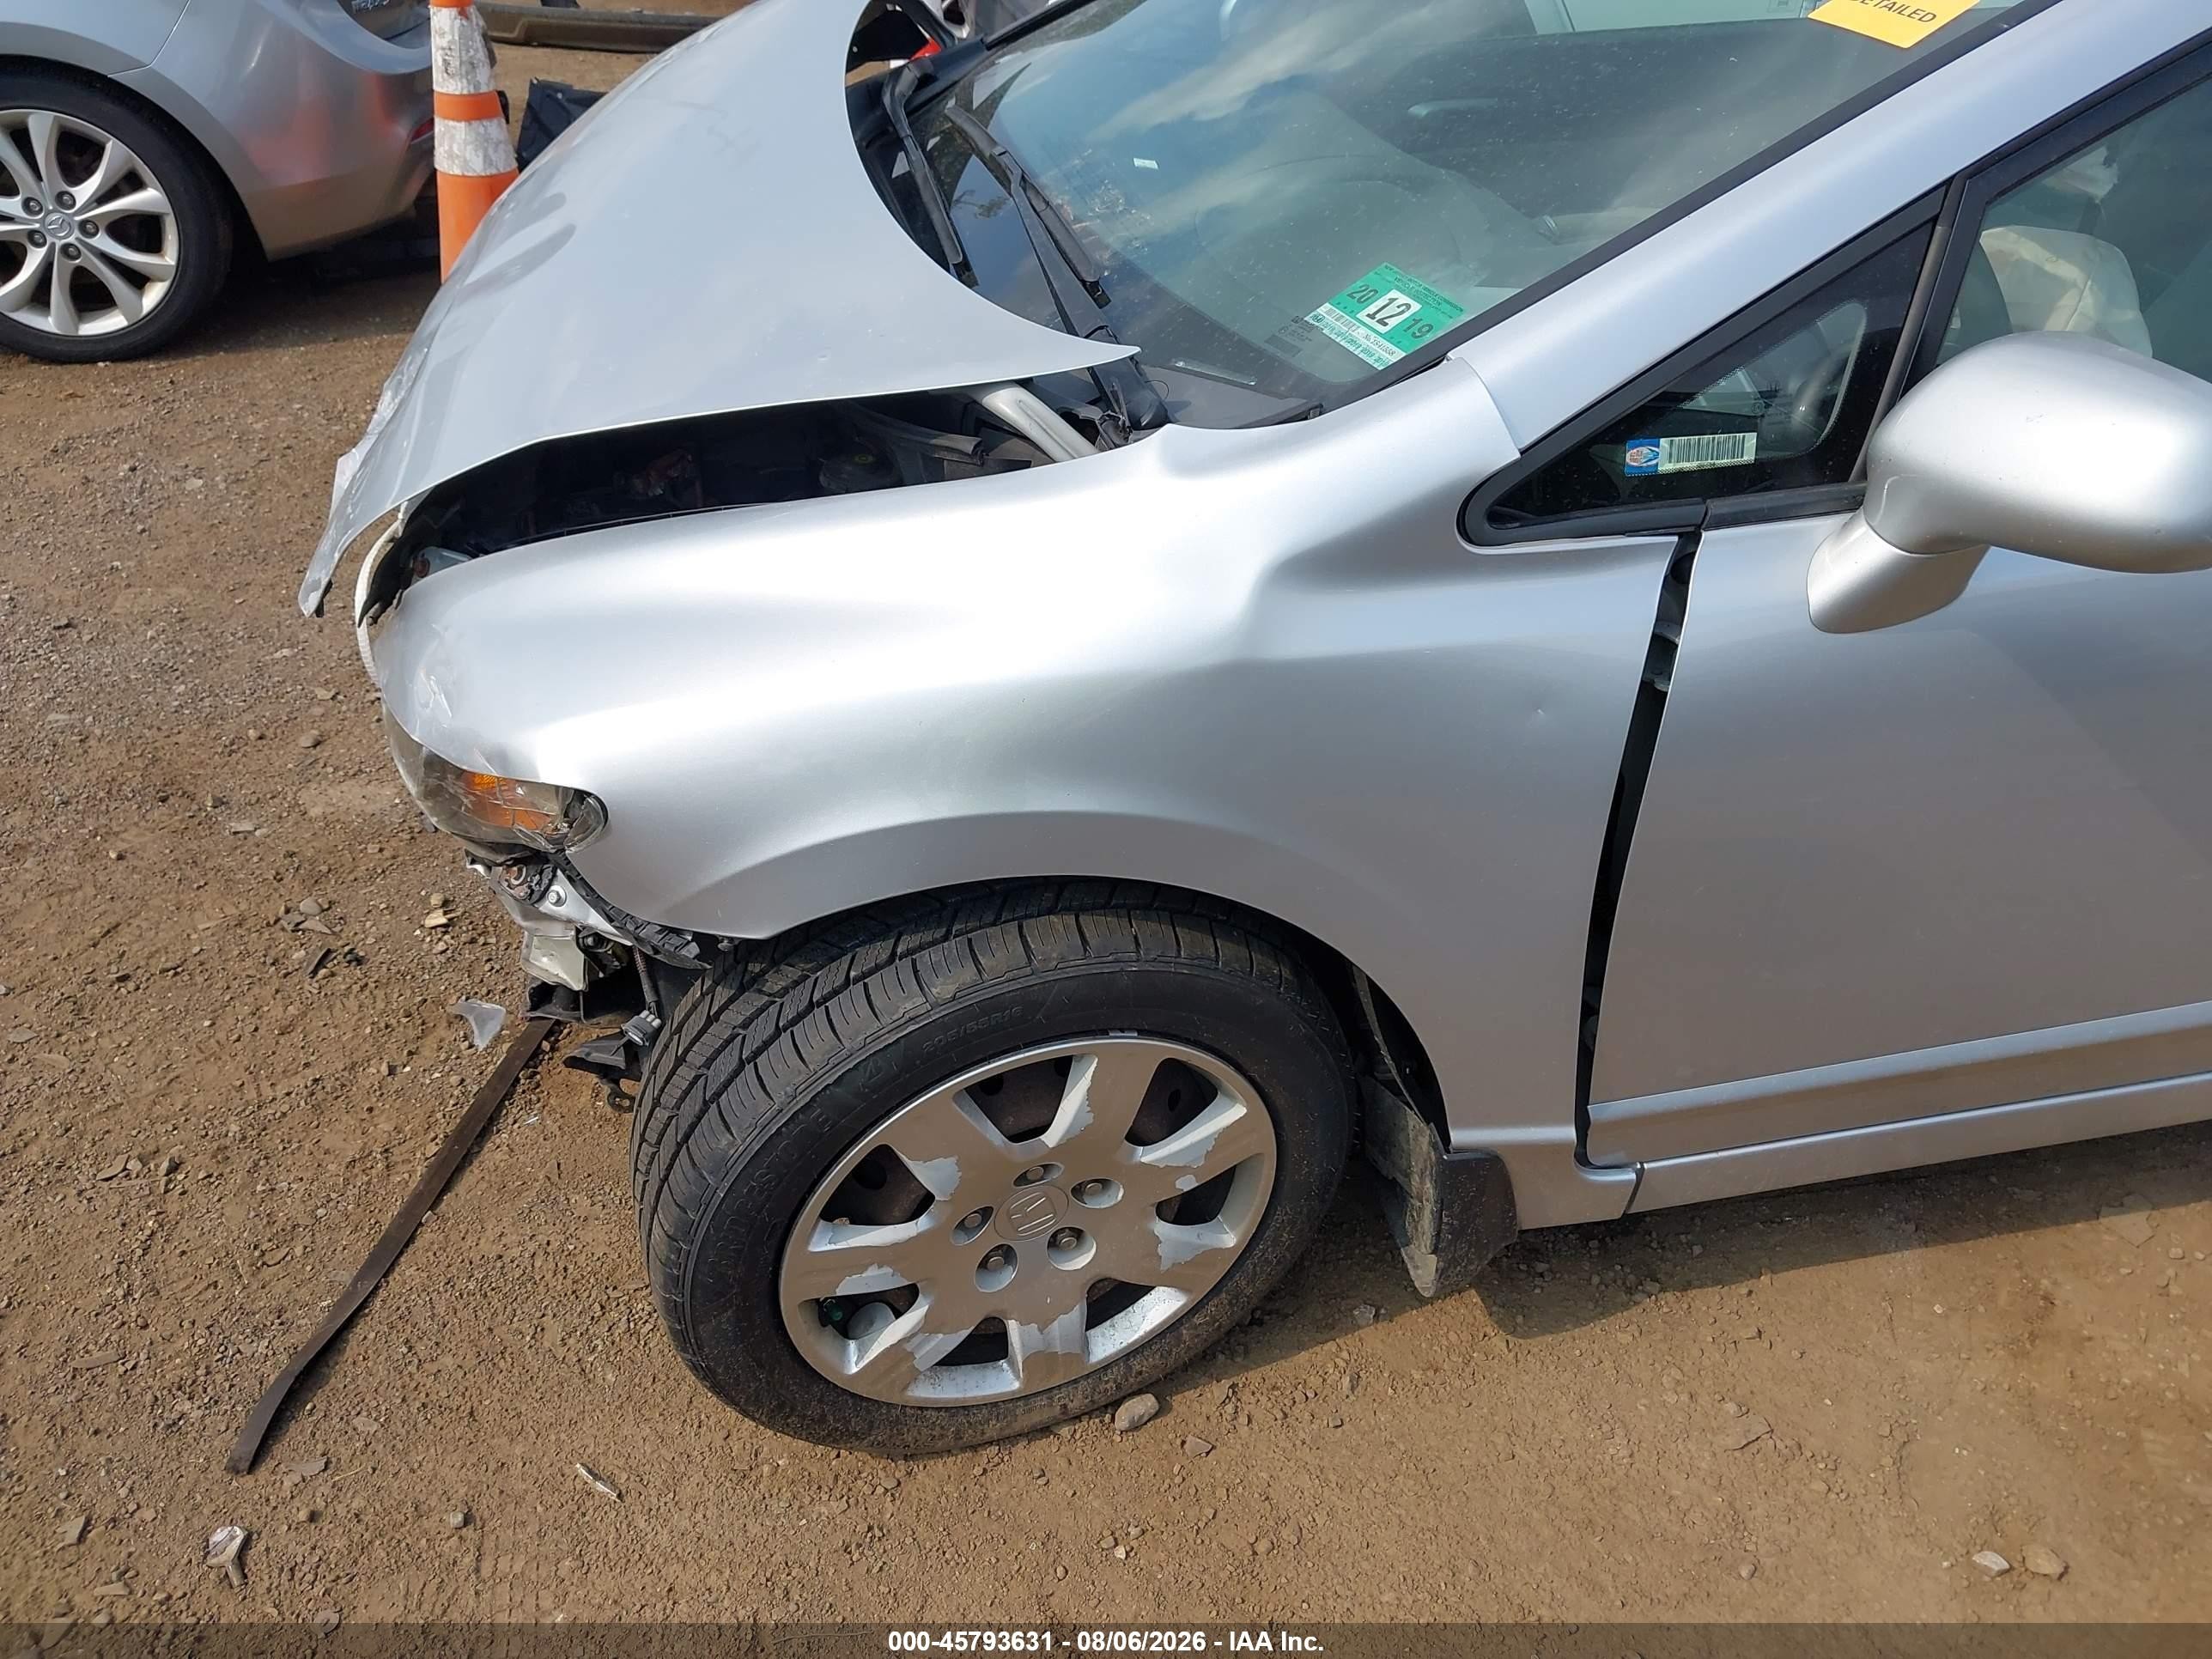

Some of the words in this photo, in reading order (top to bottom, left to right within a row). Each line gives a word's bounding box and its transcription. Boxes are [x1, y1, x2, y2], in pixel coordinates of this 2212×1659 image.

[1852, 0, 1936, 22] ETAILED
[1346, 283, 1379, 304] 20
[1365, 297, 1412, 327] 12
[1403, 317, 1434, 339] 19
